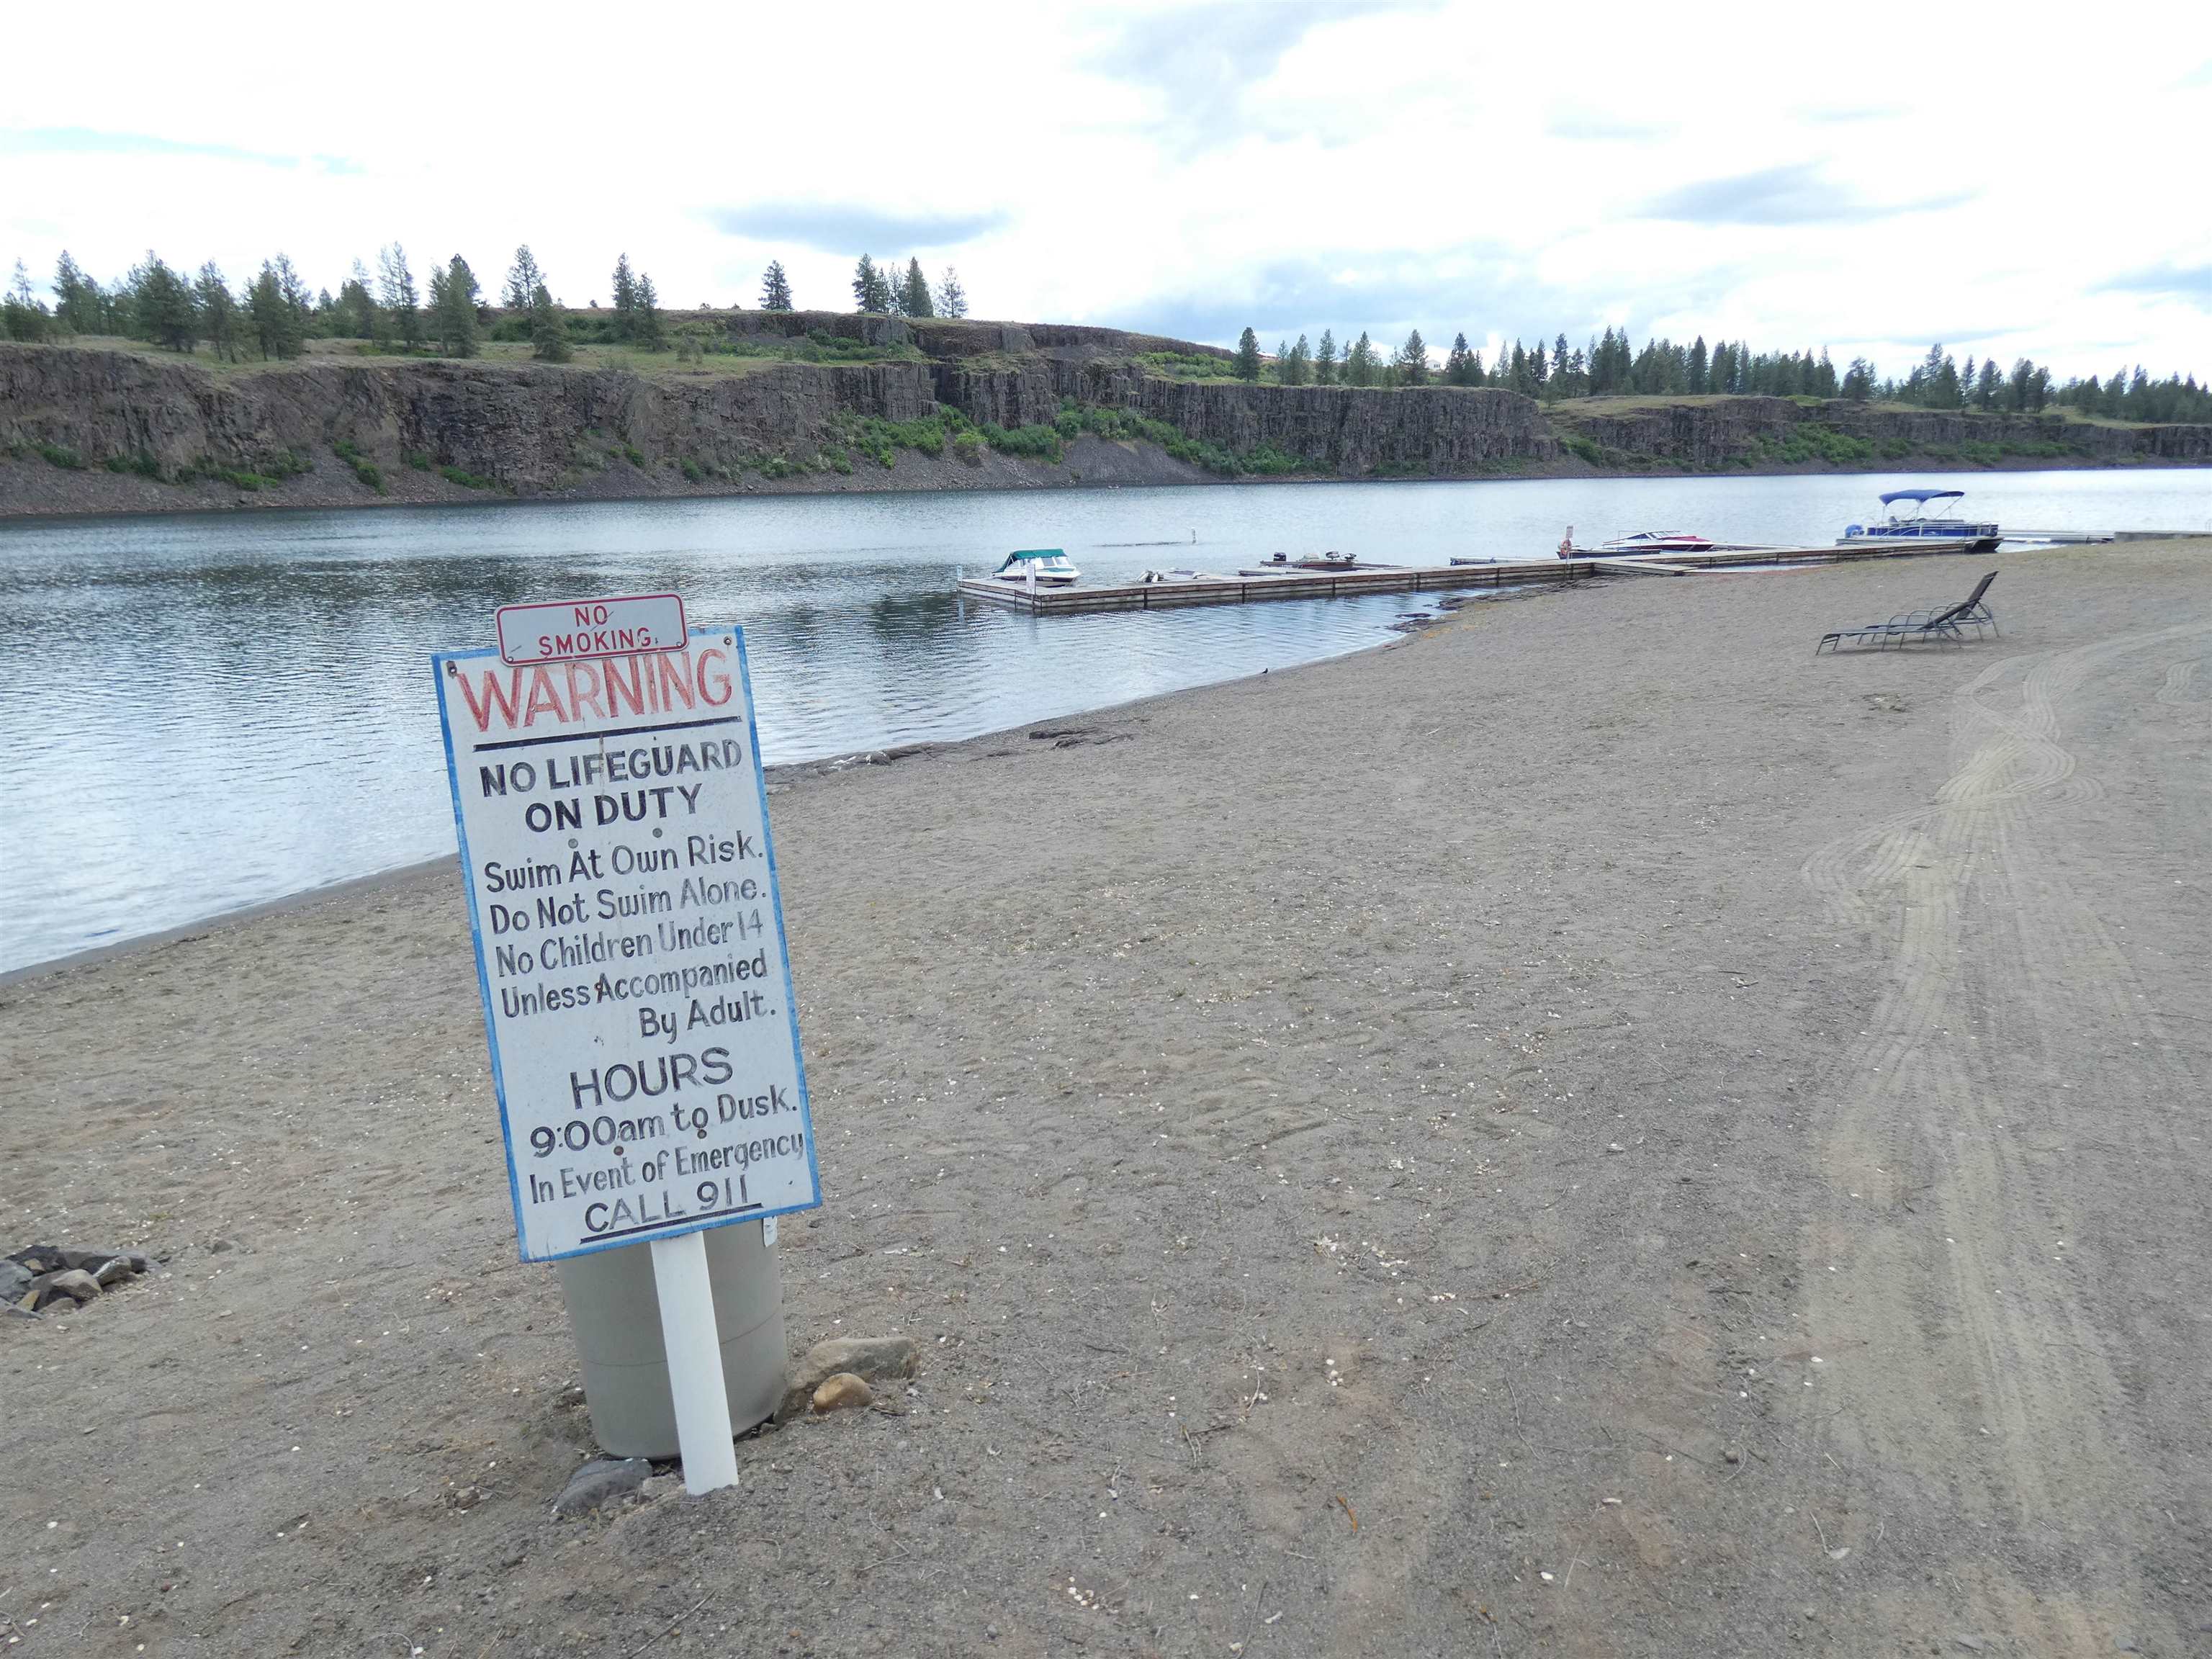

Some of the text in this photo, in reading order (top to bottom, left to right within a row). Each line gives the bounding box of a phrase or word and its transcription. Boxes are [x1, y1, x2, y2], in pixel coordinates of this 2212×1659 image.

[539, 627, 651, 656] SMOKING
[575, 605, 608, 626] NO
[457, 649, 732, 732] WARNING
[480, 739, 742, 797] NO LIFEGUARD
[526, 783, 703, 832] ON DUTY
[484, 830, 763, 893] Swim At Own Risk.
[490, 876, 767, 935] Do Not Swim Alone.
[496, 909, 763, 977] No Children Under 14
[501, 948, 768, 1018] Unless Accompanied
[639, 989, 776, 1043] By Adult.
[570, 1046, 733, 1109] HOURS
[530, 1085, 798, 1158] 9:00am to Dusk.
[530, 1133, 804, 1204] In Event of Emergency
[585, 1174, 749, 1232] CALL 911
